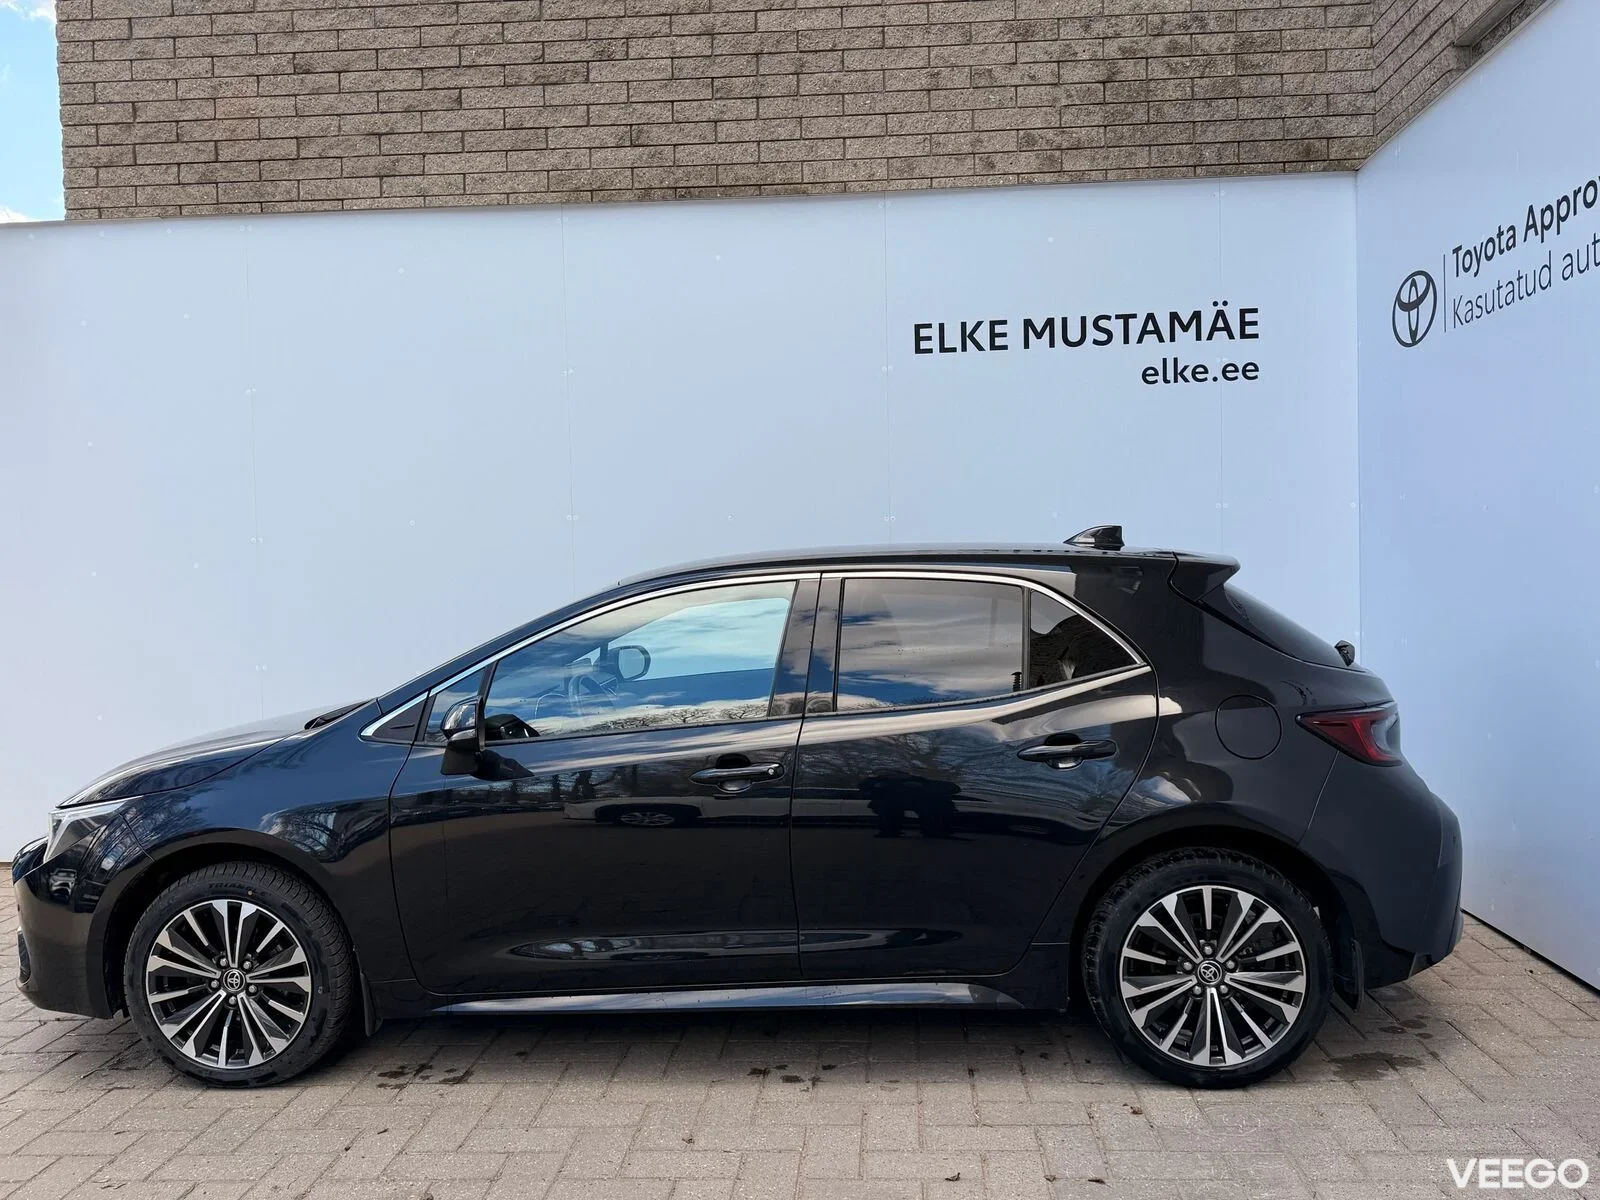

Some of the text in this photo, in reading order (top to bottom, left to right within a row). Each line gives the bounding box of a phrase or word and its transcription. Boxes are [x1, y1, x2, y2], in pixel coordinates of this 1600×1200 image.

[1452, 175, 1600, 278] Toyota Appro
[1452, 250, 1552, 329] Kasutatud
[914, 300, 1261, 355] ELKE MUSTAMÄE
[1141, 357, 1260, 385] elke.ee
